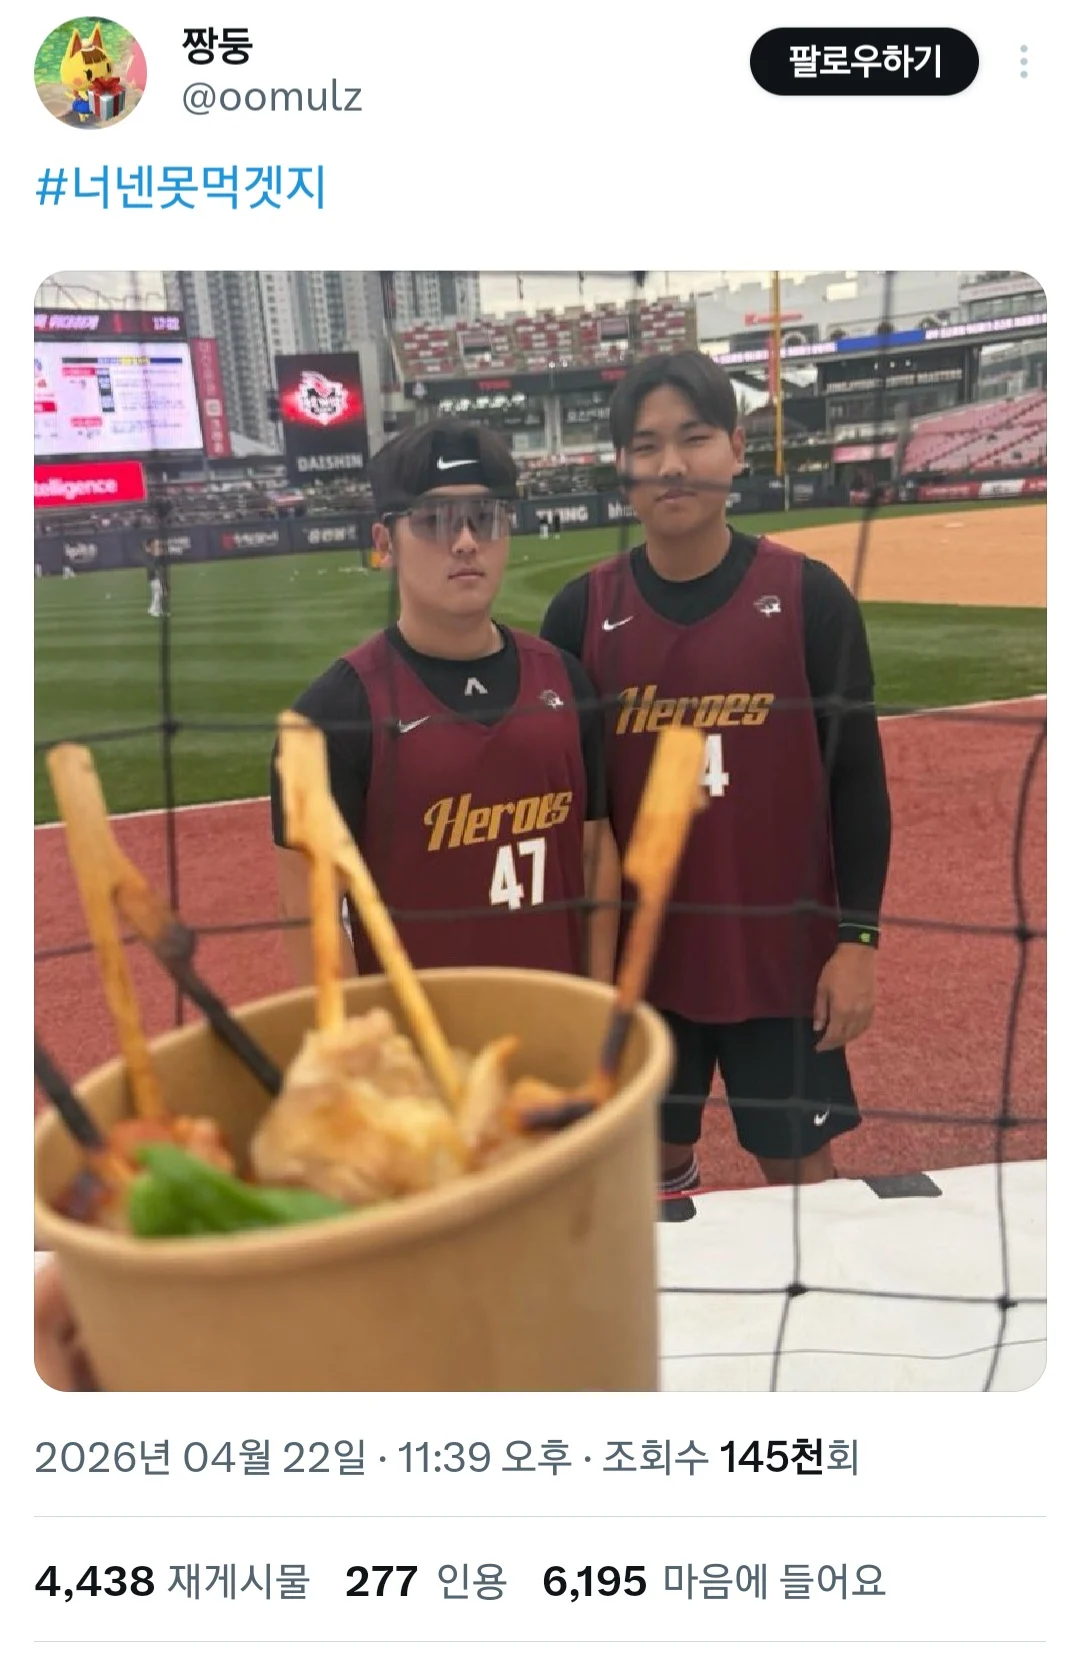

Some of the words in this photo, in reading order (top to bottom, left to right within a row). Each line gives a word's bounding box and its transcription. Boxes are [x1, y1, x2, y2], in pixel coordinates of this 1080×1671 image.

[297, 454, 363, 471] DAISHIN
[615, 684, 775, 735] Heroes
[423, 792, 573, 851] Heroes
[489, 837, 547, 910] 47
